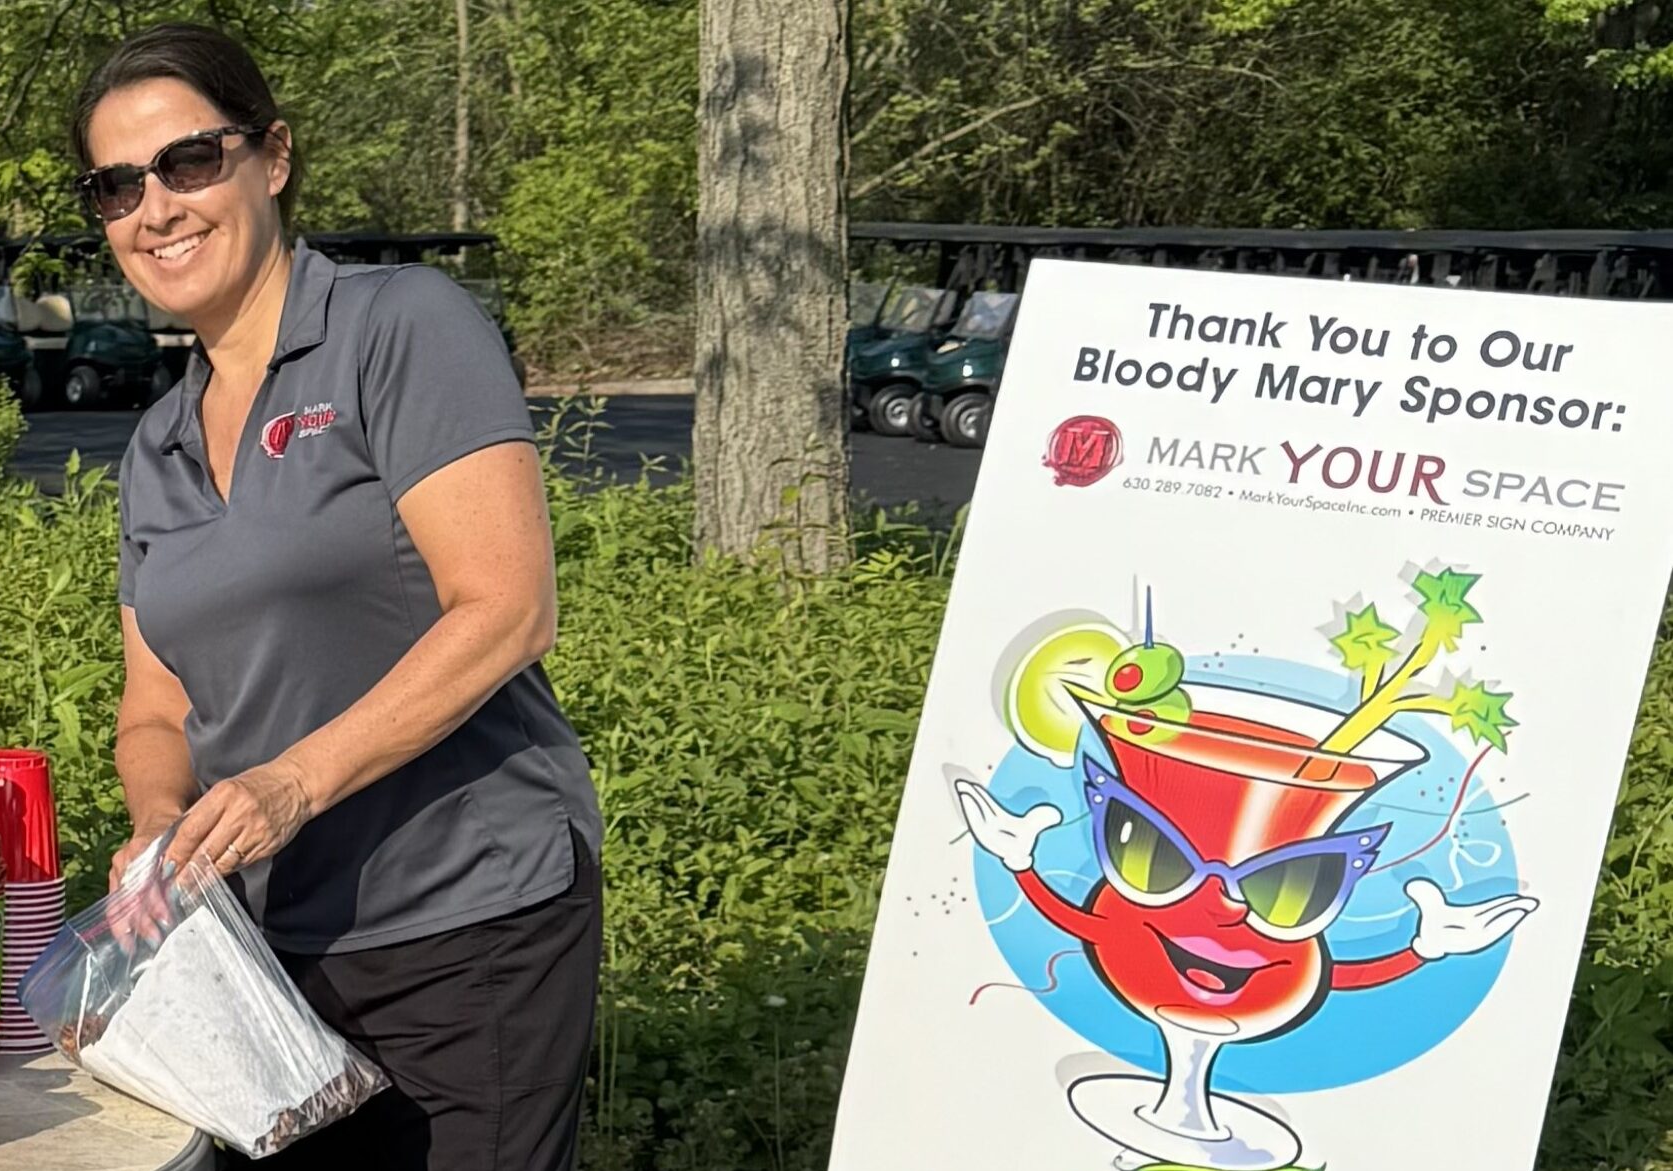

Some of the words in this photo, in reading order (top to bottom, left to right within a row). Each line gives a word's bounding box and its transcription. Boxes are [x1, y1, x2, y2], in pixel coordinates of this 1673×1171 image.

[1148, 303, 1288, 348] Thank
[1308, 314, 1390, 357] You
[1410, 324, 1458, 364] to
[1479, 329, 1574, 373] Our
[1073, 347, 1238, 403] Bloody
[1255, 362, 1382, 417] Mary
[1399, 375, 1626, 432] Sponsor:
[1146, 437, 1267, 475] MARK
[1280, 440, 1451, 506] YOUR
[1462, 469, 1625, 513] SPACE
[1239, 489, 1401, 518] MarkYourSpaceInc.com
[1420, 508, 1483, 527] PREMIER
[1486, 515, 1526, 531] SIGN
[1531, 520, 1615, 541] COMPANY
